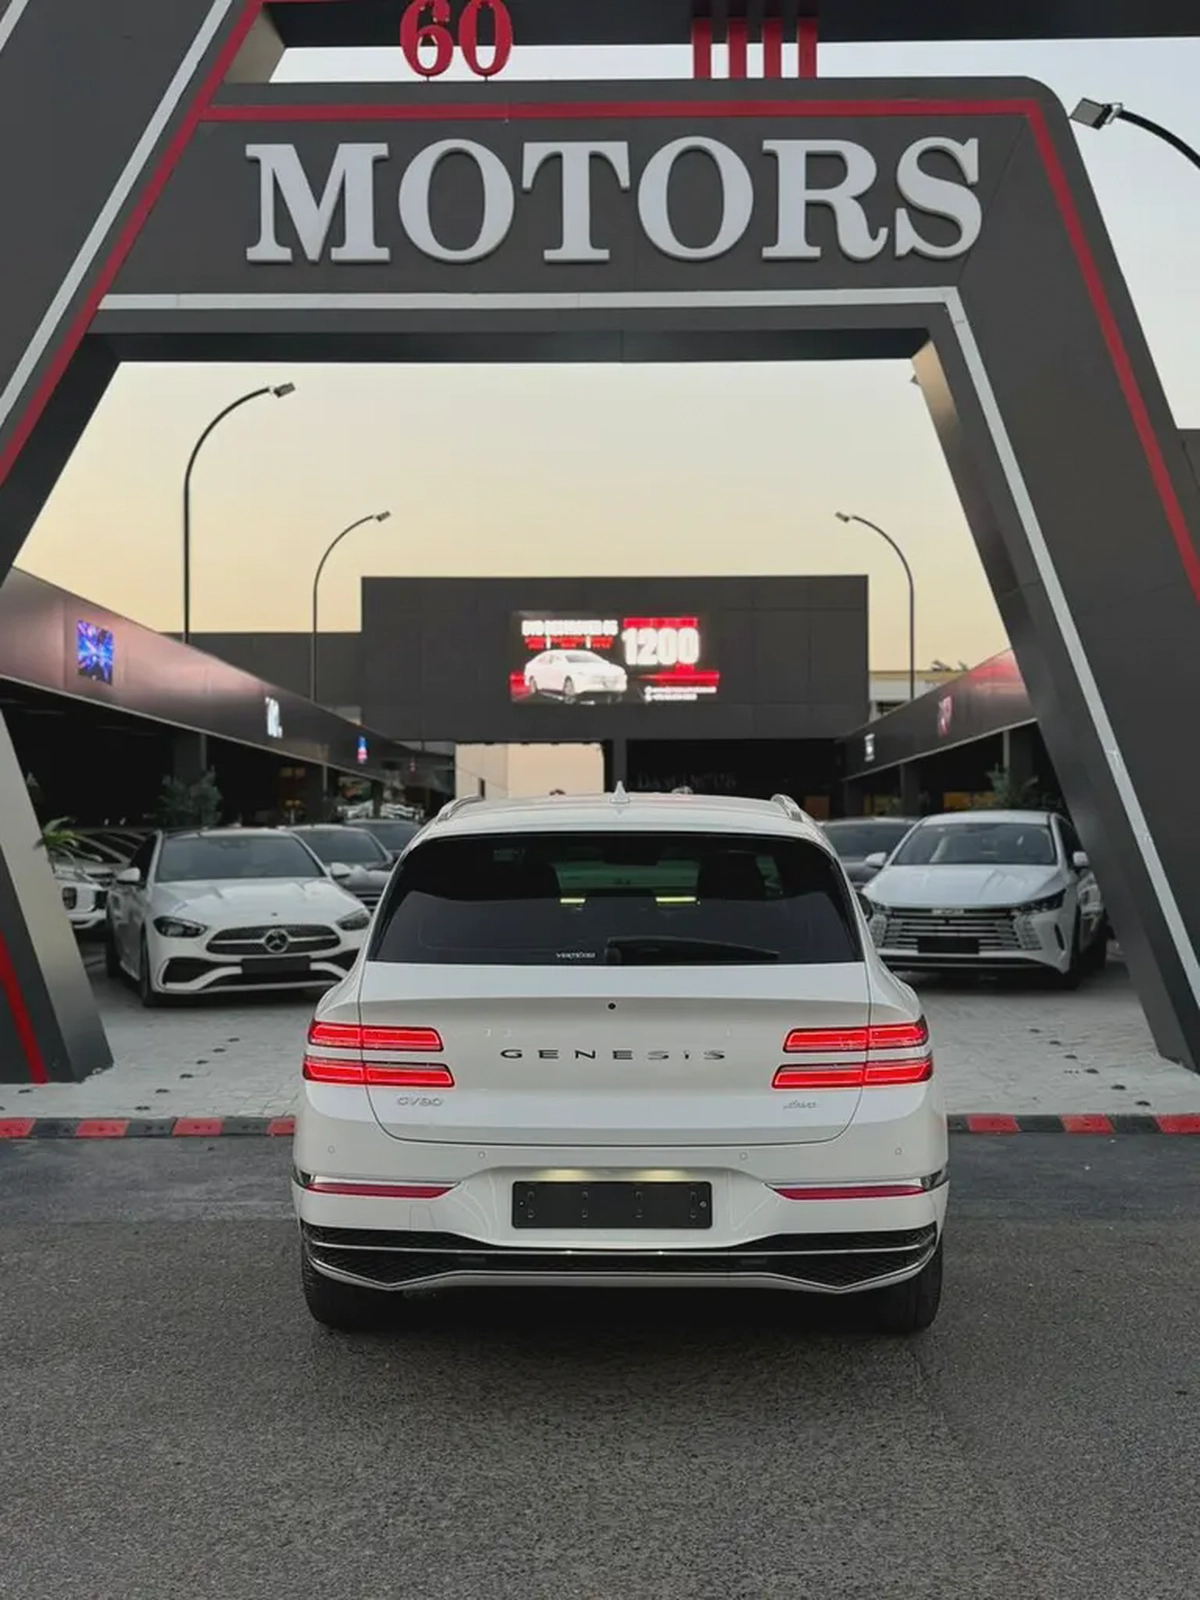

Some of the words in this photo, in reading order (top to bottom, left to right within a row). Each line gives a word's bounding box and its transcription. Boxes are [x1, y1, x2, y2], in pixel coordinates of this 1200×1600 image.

[400, 0, 513, 77] 60
[245, 136, 983, 264] MOTORS
[621, 627, 700, 666] 1200
[499, 1049, 726, 1061] GENESIS
